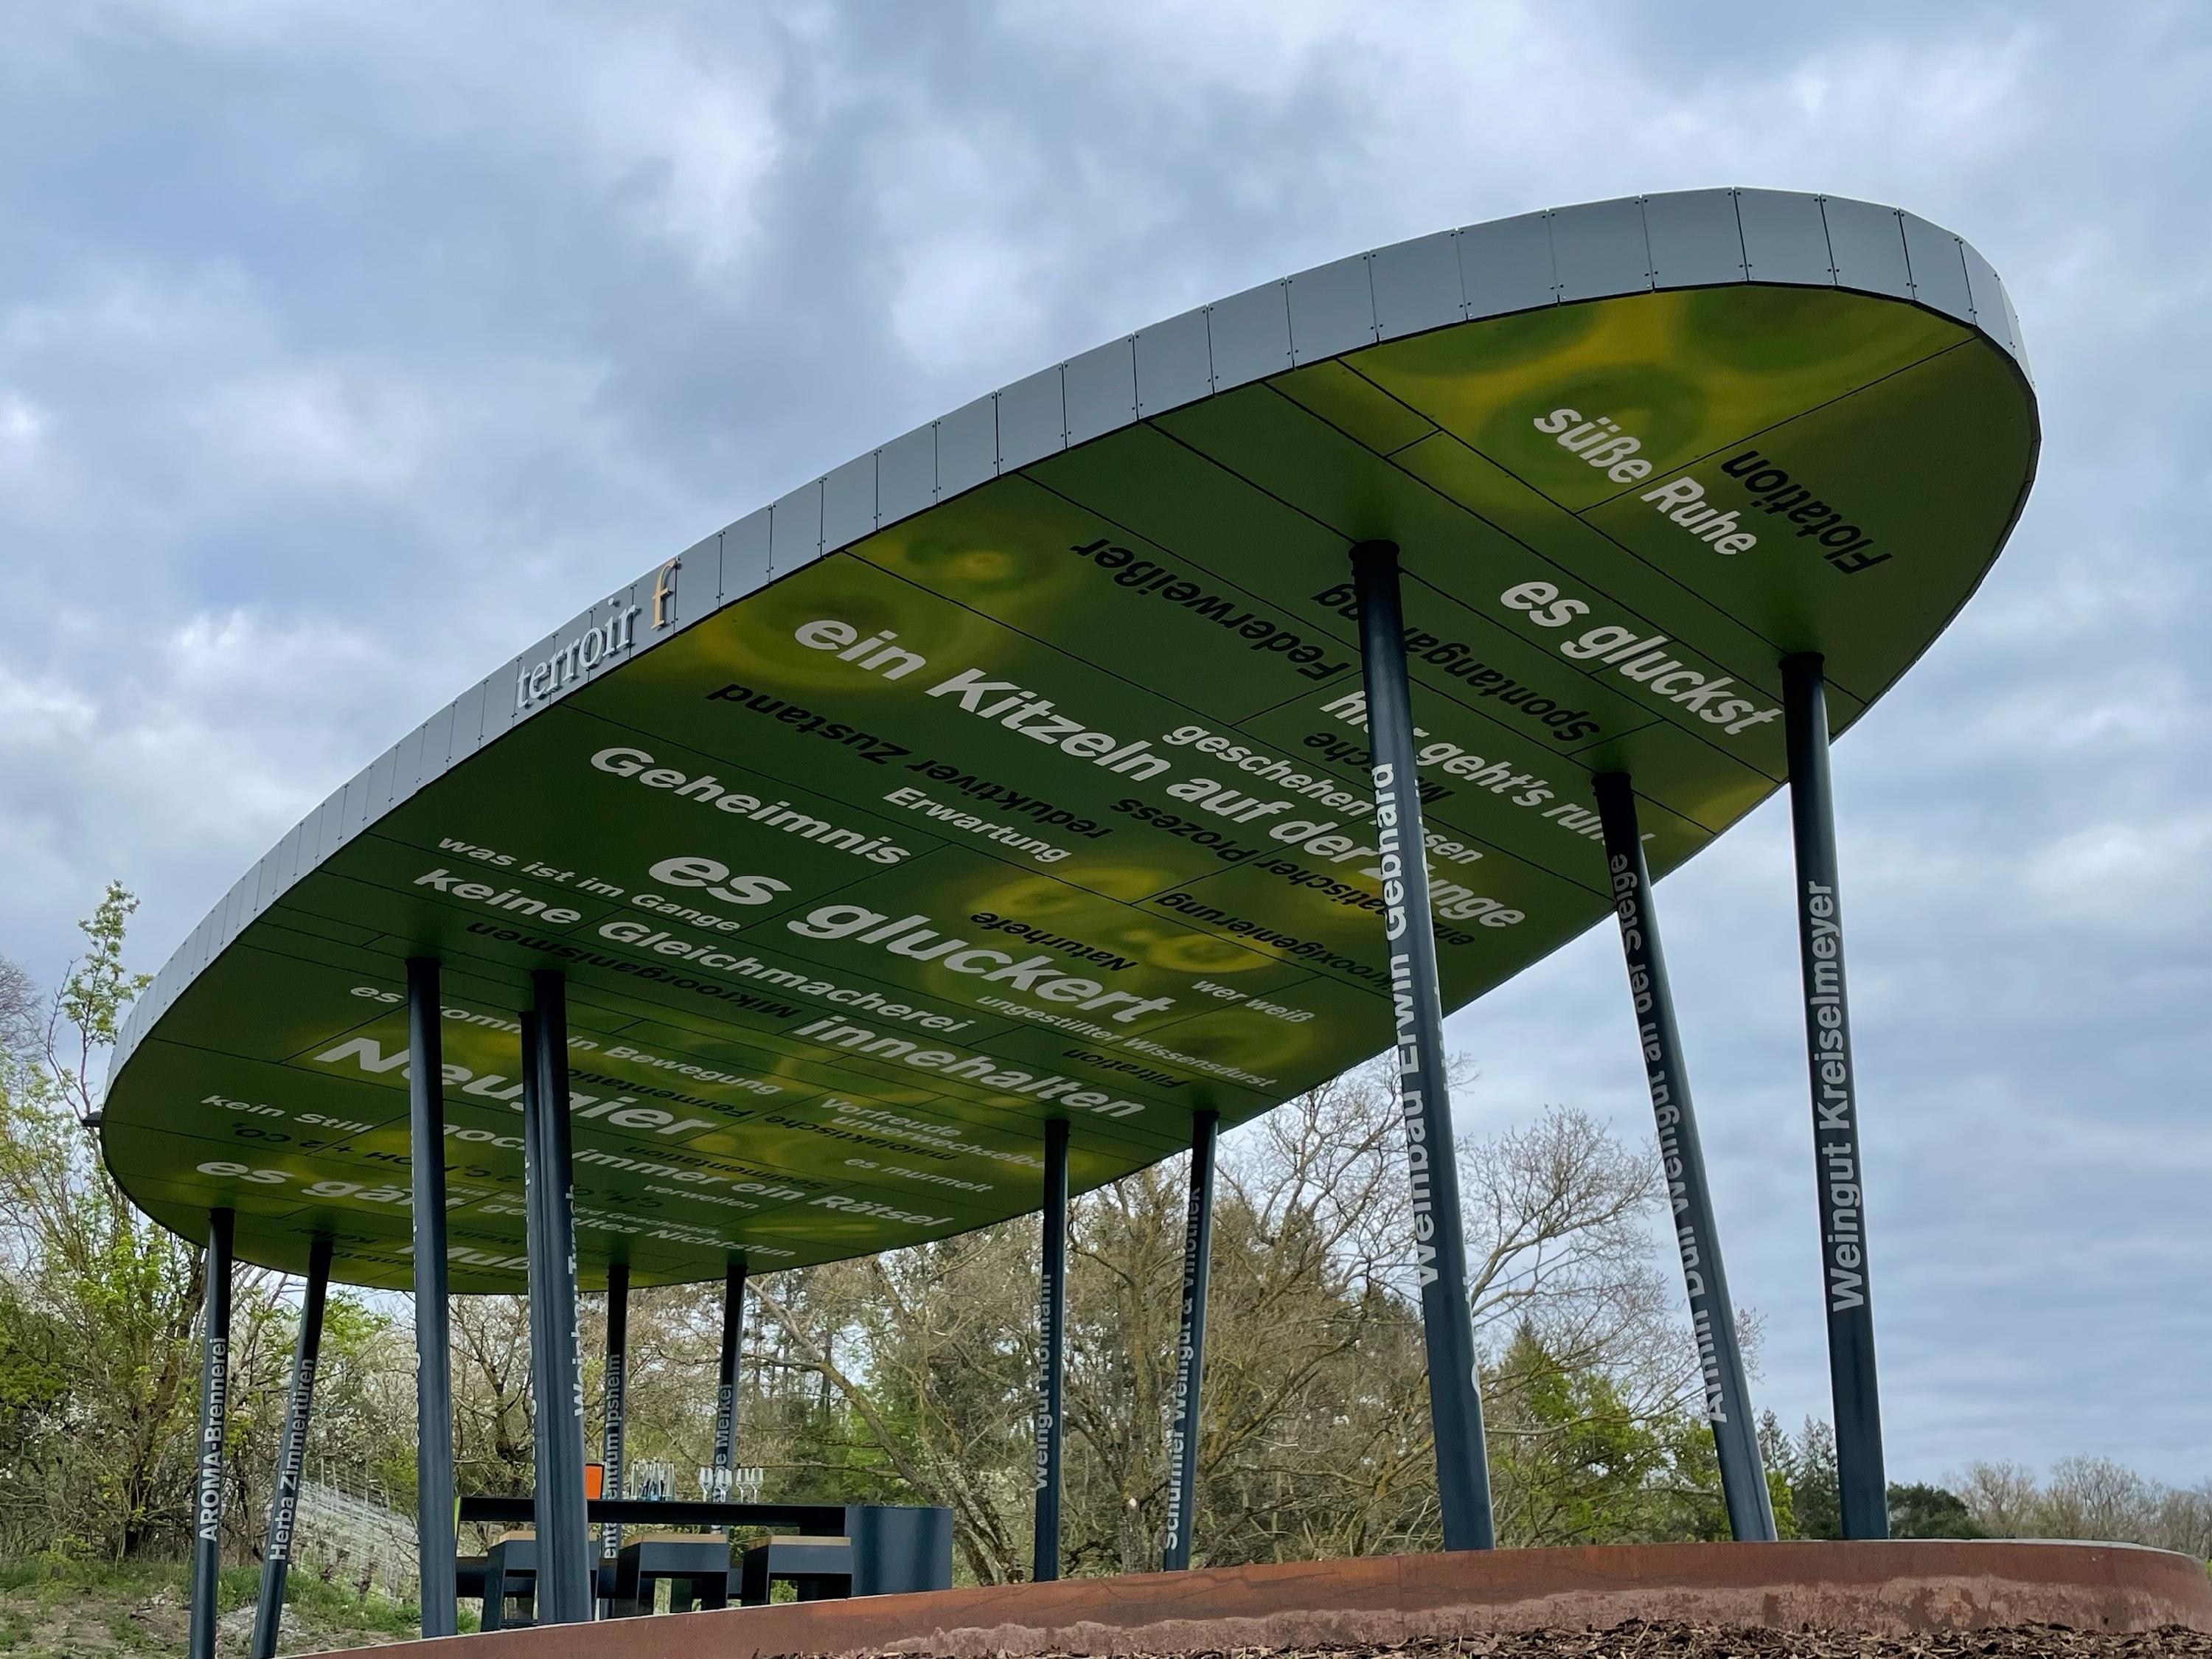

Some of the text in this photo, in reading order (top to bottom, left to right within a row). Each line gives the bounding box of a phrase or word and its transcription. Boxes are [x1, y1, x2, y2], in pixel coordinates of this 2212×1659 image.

[1534, 408, 1757, 555] süße Ruhe
[1721, 451, 1893, 574] Flotation
[518, 557, 678, 708] terroir f
[1069, 538, 1350, 681] Federweißer
[1500, 581, 1784, 736] es gluckst
[706, 684, 1113, 840] reduktiver Zustand
[794, 620, 927, 681] ein
[925, 667, 1172, 782] Kitzeln
[1166, 777, 1295, 824] auf
[1268, 820, 1379, 863] der
[1162, 725, 1374, 817] geschehen
[1416, 740, 1556, 807] geht's
[1541, 801, 1655, 844] run
[591, 747, 911, 864] Geheimnis
[883, 786, 1072, 863] Erwartung
[1110, 798, 1260, 863] Prozess
[437, 838, 740, 931] was ist im Gange
[1610, 852, 1643, 956] Steige
[465, 922, 804, 1019] Mikroorganismen
[598, 921, 977, 1033] Gleichmacherei
[648, 856, 1177, 1023] es gluckert
[970, 911, 1138, 973] Naturhefe
[1628, 961, 1654, 1013] der
[350, 987, 405, 1004] es
[602, 1046, 785, 1095] Bewegung
[975, 995, 1279, 1088] ungestillter Wissensdurst
[1191, 980, 1315, 1023] wer weiß
[1371, 762, 1439, 1287] Weinbau Erwin Gebhard
[1638, 1021, 1662, 1062] an
[201, 1095, 375, 1133] kein Still
[568, 1068, 959, 1161] malolaktische Fermentatio
[791, 1015, 1147, 1118] innehalten
[821, 1098, 961, 1137] Vorfreude
[1062, 1048, 1190, 1088] Filtration
[1806, 879, 1865, 1312] Weingut Kreiselmeyer
[195, 1161, 296, 1184] es
[571, 1148, 731, 1184] immer
[731, 1182, 807, 1201] ein
[807, 1194, 956, 1226] Rätsel
[625, 1147, 830, 1191] Sedimentation
[831, 1116, 1044, 1169] unverwechselba
[844, 1158, 997, 1193] es murmelt
[1648, 1070, 1690, 1216] Weingut
[1693, 1308, 1728, 1423] Armin
[199, 1337, 226, 1542] AROMA-Brennerei
[269, 1358, 315, 1560] Herba Zimmertüren
[1035, 1387, 1053, 1489] Weingut
